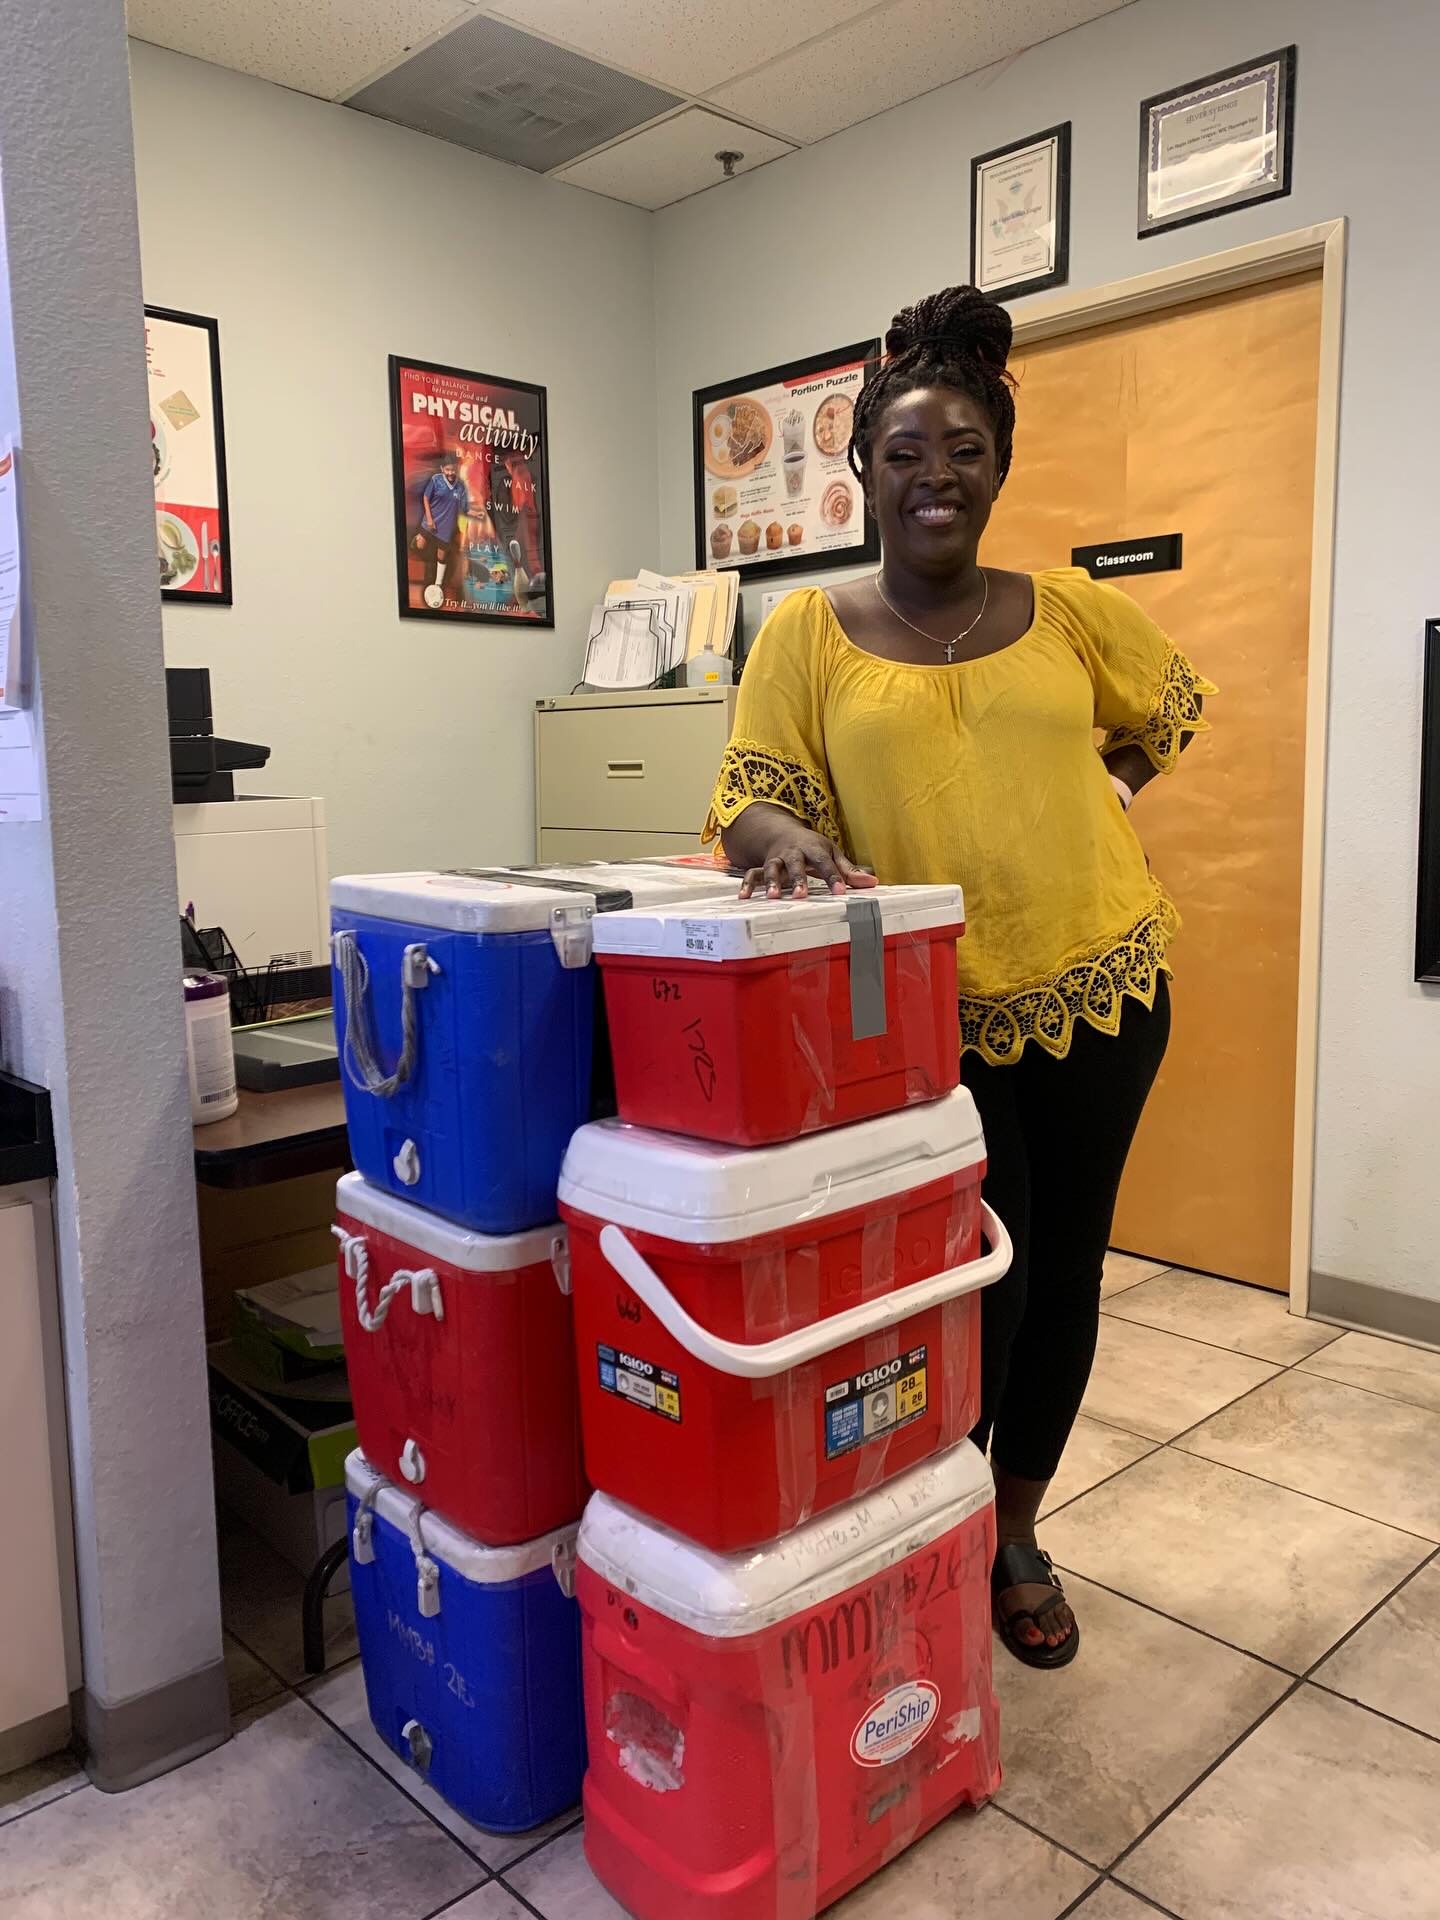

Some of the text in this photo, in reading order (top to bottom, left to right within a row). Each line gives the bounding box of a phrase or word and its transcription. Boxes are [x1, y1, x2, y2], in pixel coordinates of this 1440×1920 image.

[422, 375, 440, 386] YOUR
[441, 379, 470, 392] BALANCE
[790, 381, 824, 398] Portion
[826, 373, 859, 388] Puzzle
[431, 384, 488, 403] between food and
[412, 392, 519, 431] PHYSICAL
[460, 423, 539, 460] activity
[455, 449, 501, 465] DANCE
[504, 479, 537, 493] WALK
[486, 501, 520, 514] SWIM
[469, 543, 500, 554] PLAY
[1096, 551, 1154, 567] Classroom
[445, 598, 458, 610] Try
[619, 1352, 654, 1375] IGLOO
[856, 1359, 902, 1390] IGLOO
[901, 1376, 916, 1394] 28
[912, 1391, 923, 1405] 26
[864, 1699, 930, 1744] PeriShip
